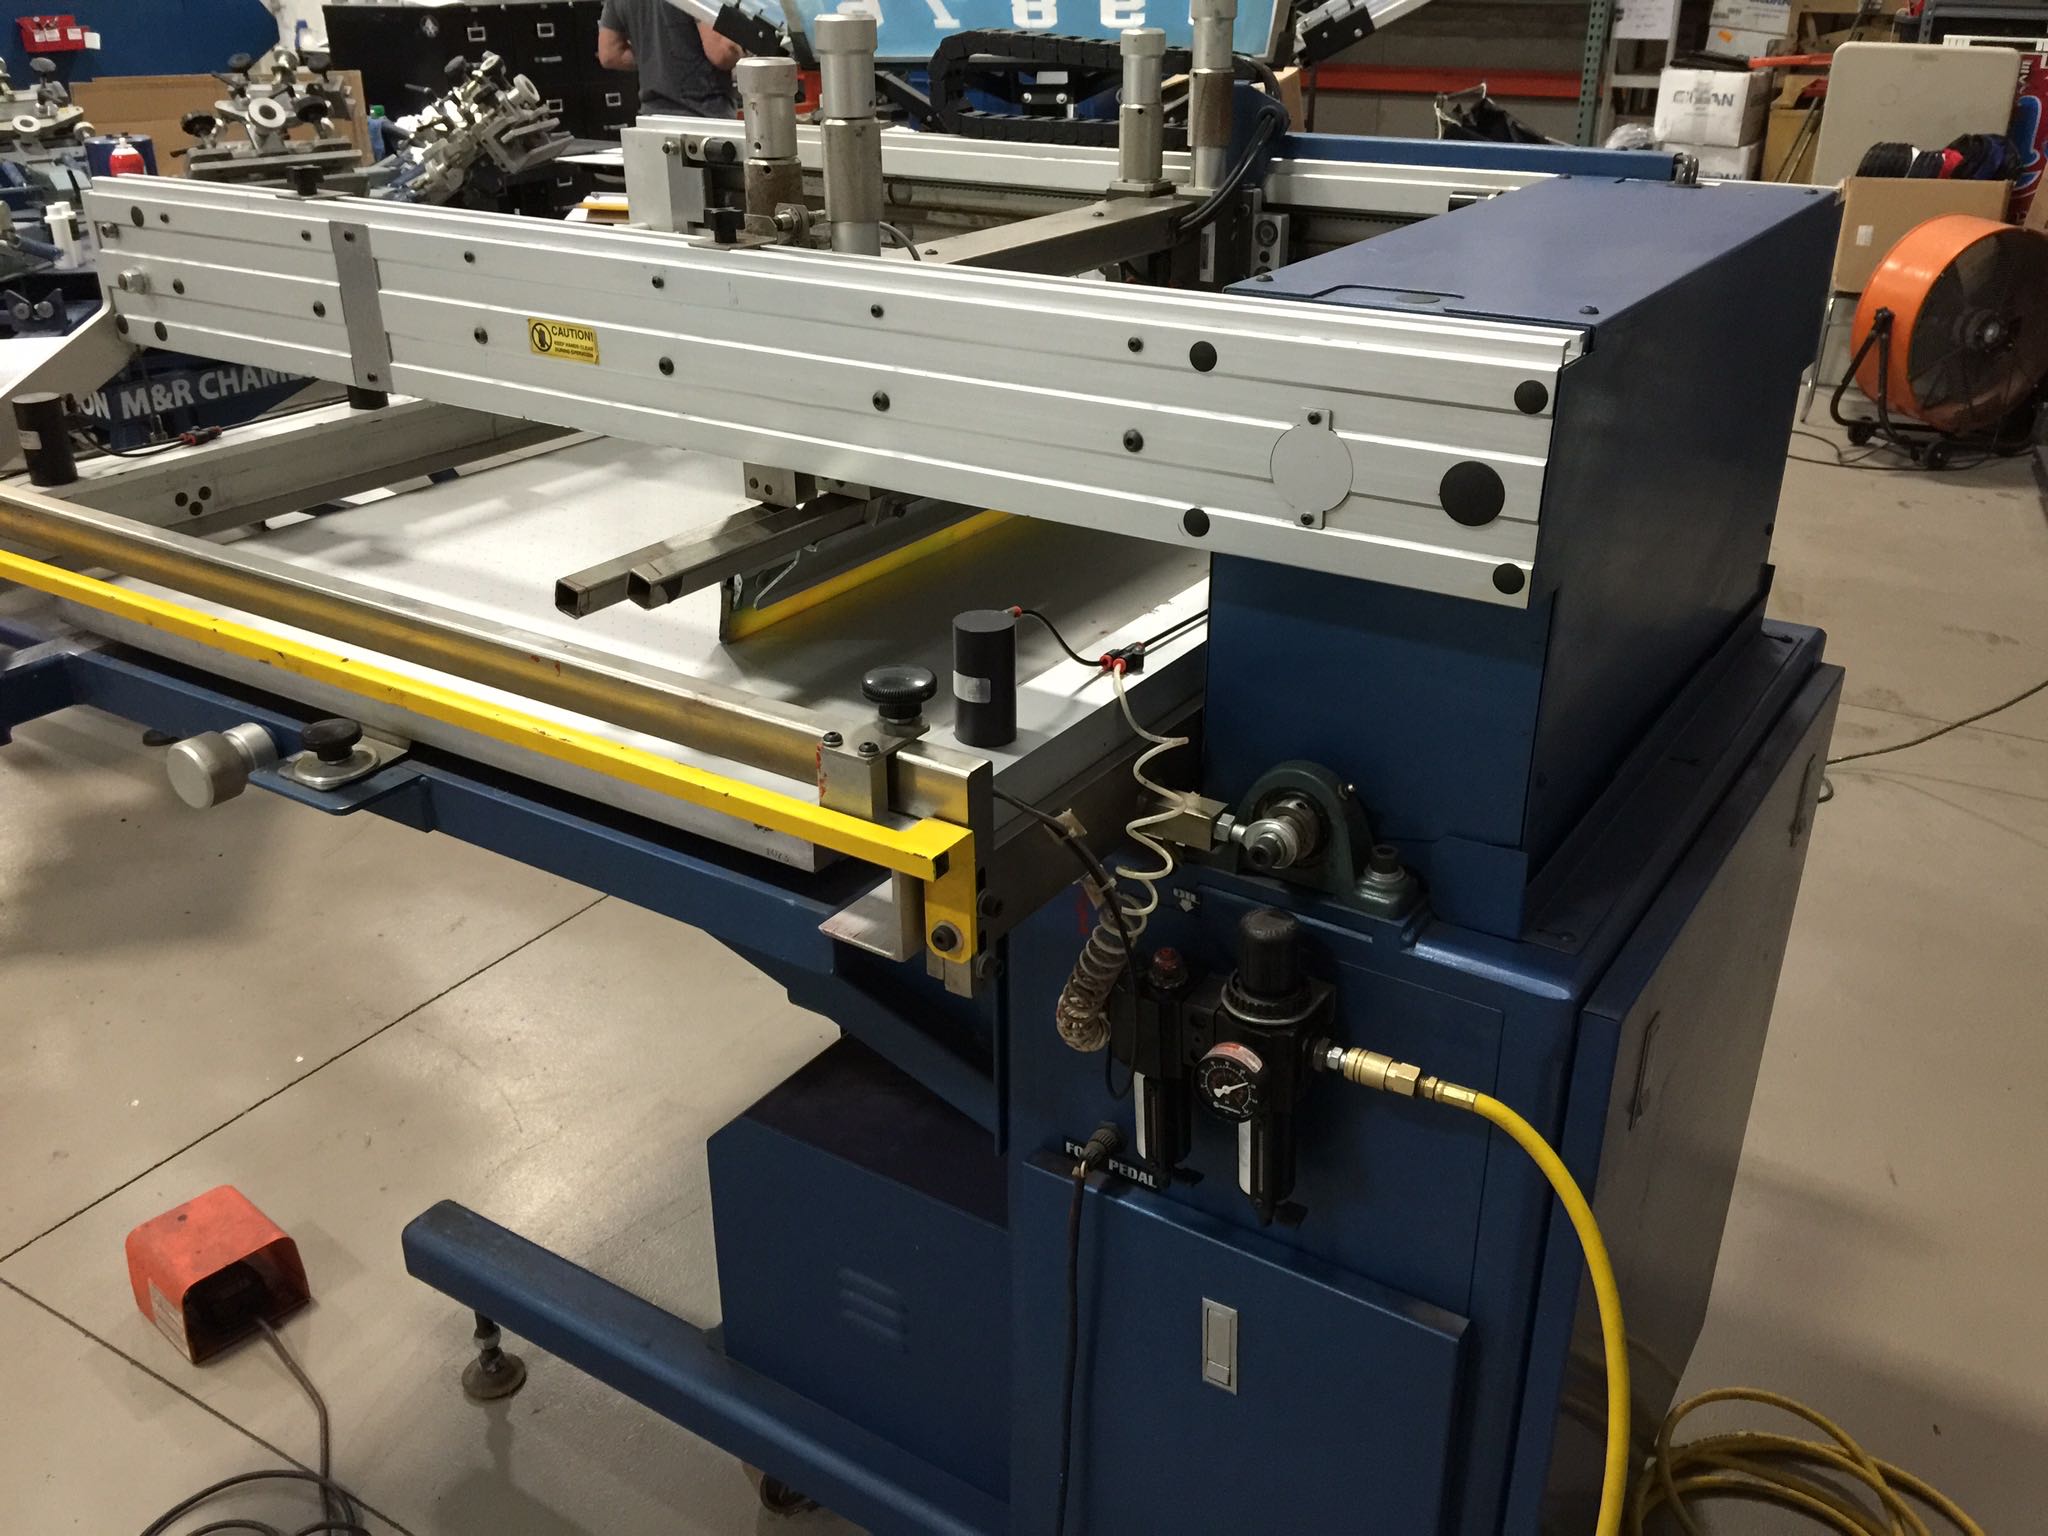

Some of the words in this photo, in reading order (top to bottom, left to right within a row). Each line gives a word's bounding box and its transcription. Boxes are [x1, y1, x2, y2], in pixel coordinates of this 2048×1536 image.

[552, 326, 594, 342] CAUTION!
[120, 379, 194, 420] M&R
[199, 366, 298, 400] CHAM
[1108, 1158, 1158, 1189] PEDAL
